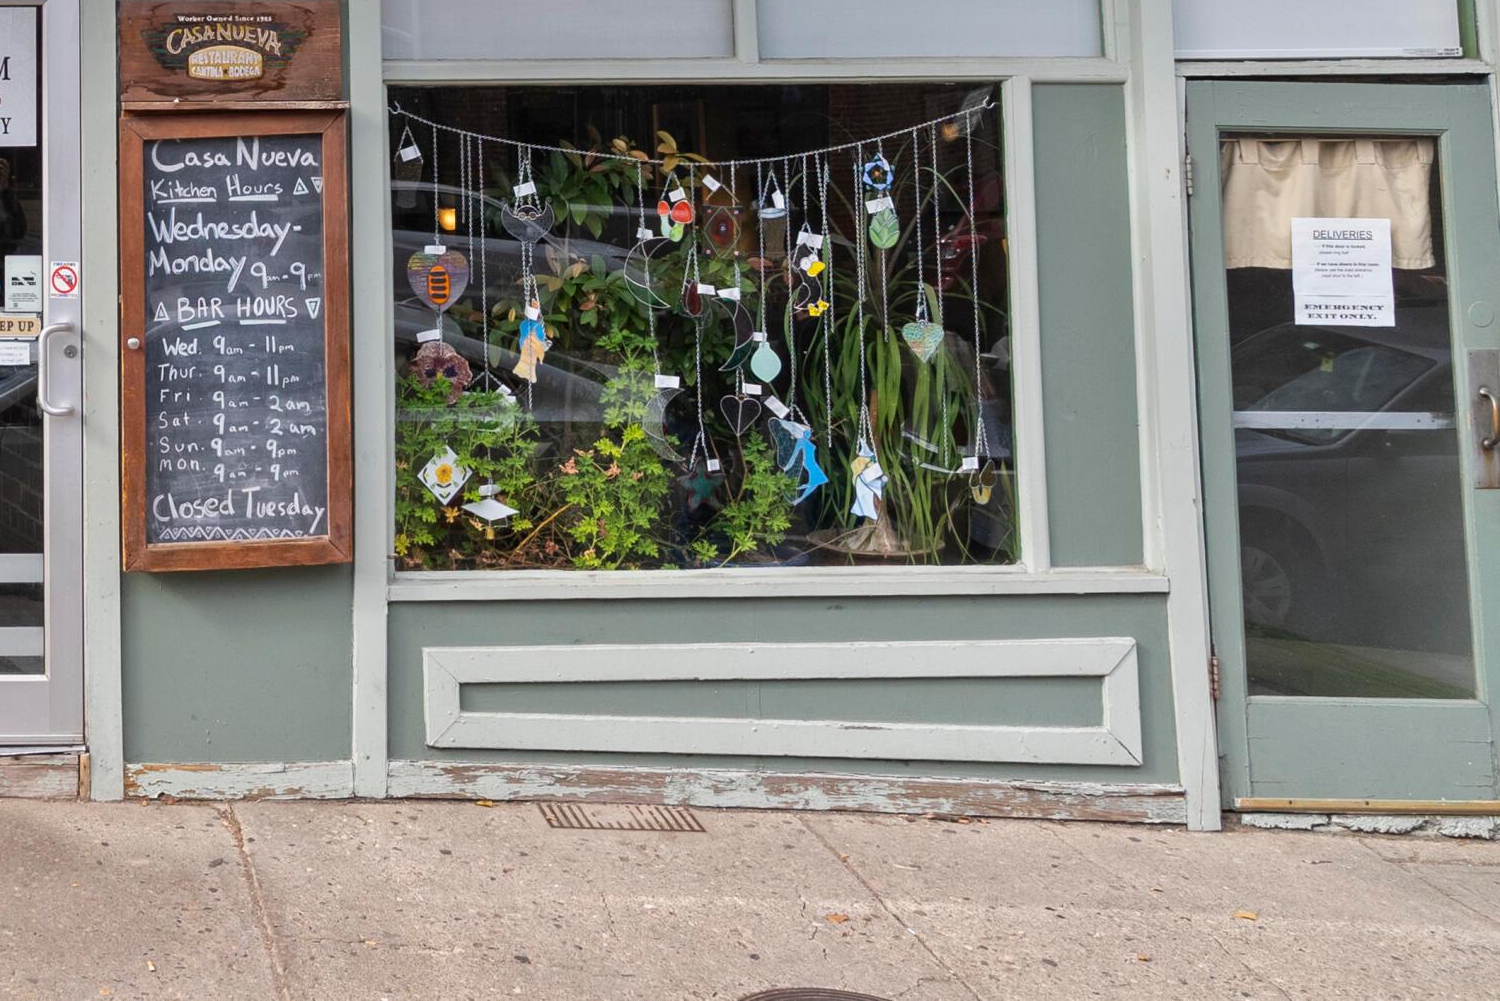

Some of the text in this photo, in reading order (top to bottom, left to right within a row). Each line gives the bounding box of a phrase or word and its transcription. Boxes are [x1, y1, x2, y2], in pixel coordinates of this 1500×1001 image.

[191, 65, 261, 77] CANTINA BODEGA
[151, 137, 319, 172] Casa Nueva
[151, 174, 284, 200] Kitchen Hours
[1313, 230, 1373, 240] DELIVERIES
[150, 246, 246, 293] Monday
[177, 296, 298, 322] BAR HOURS
[18, 320, 35, 332] UP
[153, 486, 325, 534] Closed Tuesday
